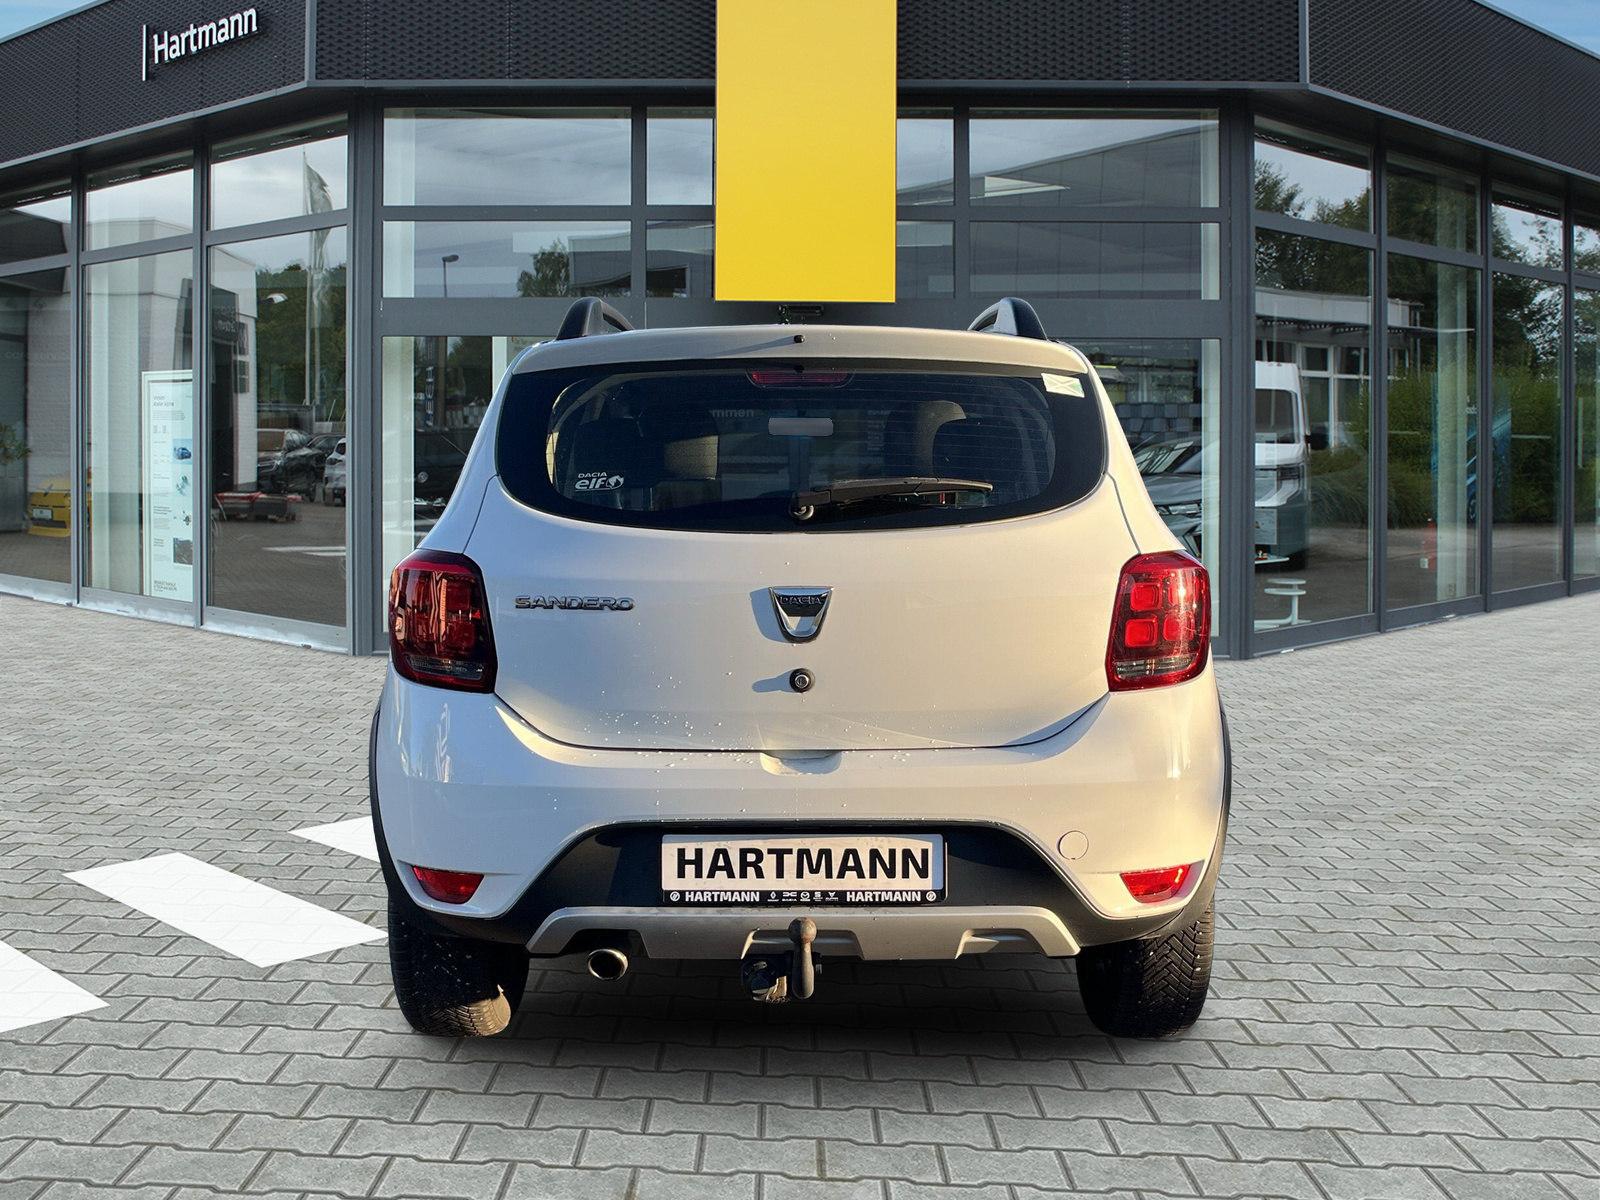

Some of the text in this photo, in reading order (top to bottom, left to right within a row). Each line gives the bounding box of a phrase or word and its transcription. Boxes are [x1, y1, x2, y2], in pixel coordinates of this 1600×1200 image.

[153, 8, 258, 64] Hartmann
[577, 471, 608, 479] DACIA
[515, 595, 634, 611] SANDERO
[780, 596, 822, 605] DACIA
[677, 848, 929, 879] HARTMANN
[685, 892, 760, 902] HARTMANN
[846, 892, 921, 902] HARTMANN
